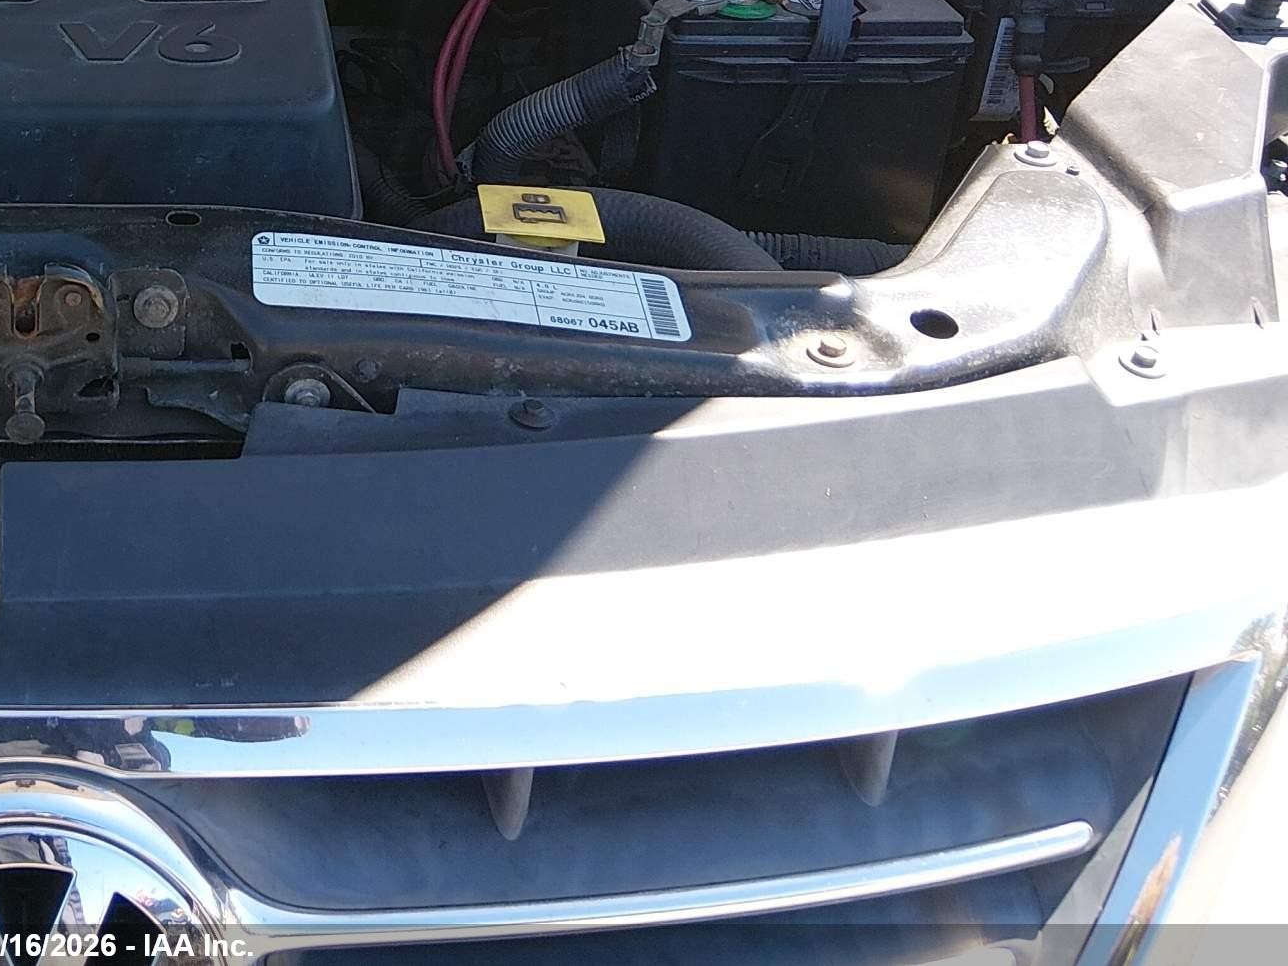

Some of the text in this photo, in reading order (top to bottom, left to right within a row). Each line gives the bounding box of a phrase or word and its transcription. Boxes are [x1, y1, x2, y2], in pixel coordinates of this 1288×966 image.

[57, 17, 243, 66] V6
[451, 254, 572, 275] Chrysler Group LLC
[550, 315, 639, 333] 68067 045AB
